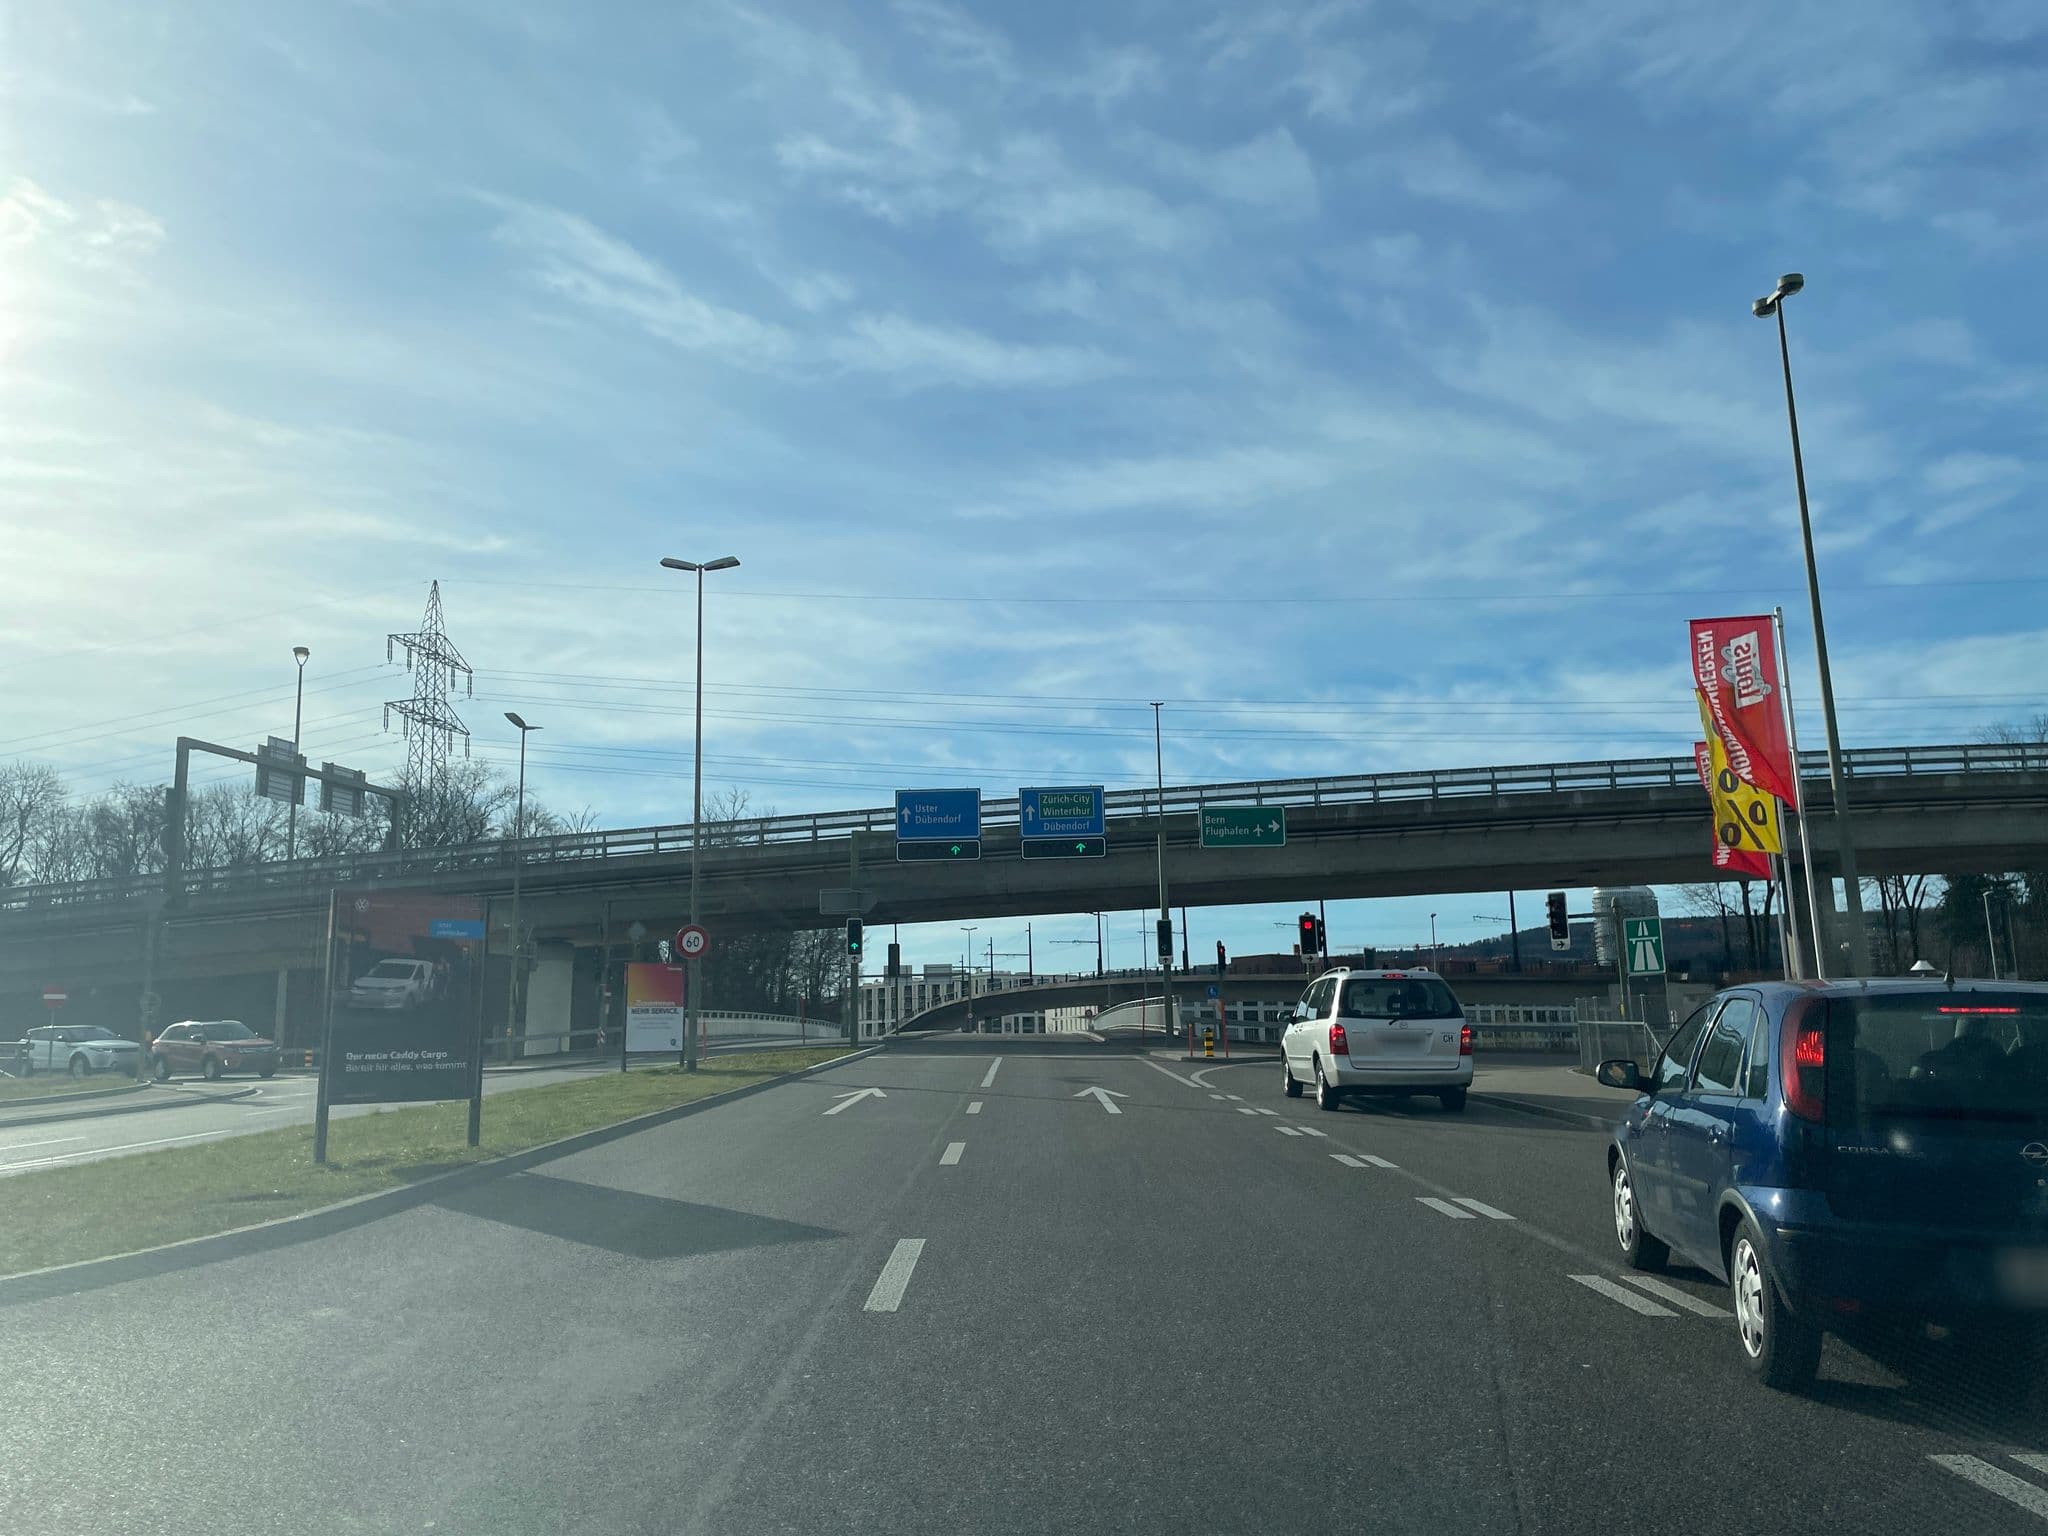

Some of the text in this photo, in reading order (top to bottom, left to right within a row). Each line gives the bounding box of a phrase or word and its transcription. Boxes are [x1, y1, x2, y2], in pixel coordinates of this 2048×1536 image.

[1041, 794, 1090, 805] Zürich-City
[915, 804, 938, 813] Uster
[1042, 806, 1090, 816] Winterthur
[915, 814, 961, 824] Dübendorf
[1205, 815, 1226, 824] Bern
[1043, 821, 1090, 831] Dübendorf
[1205, 826, 1250, 837] Flughafen
[686, 936, 700, 948] 60
[1442, 1034, 1454, 1043] CH
[390, 1050, 419, 1061] Caddy
[421, 1050, 448, 1060] Cargo
